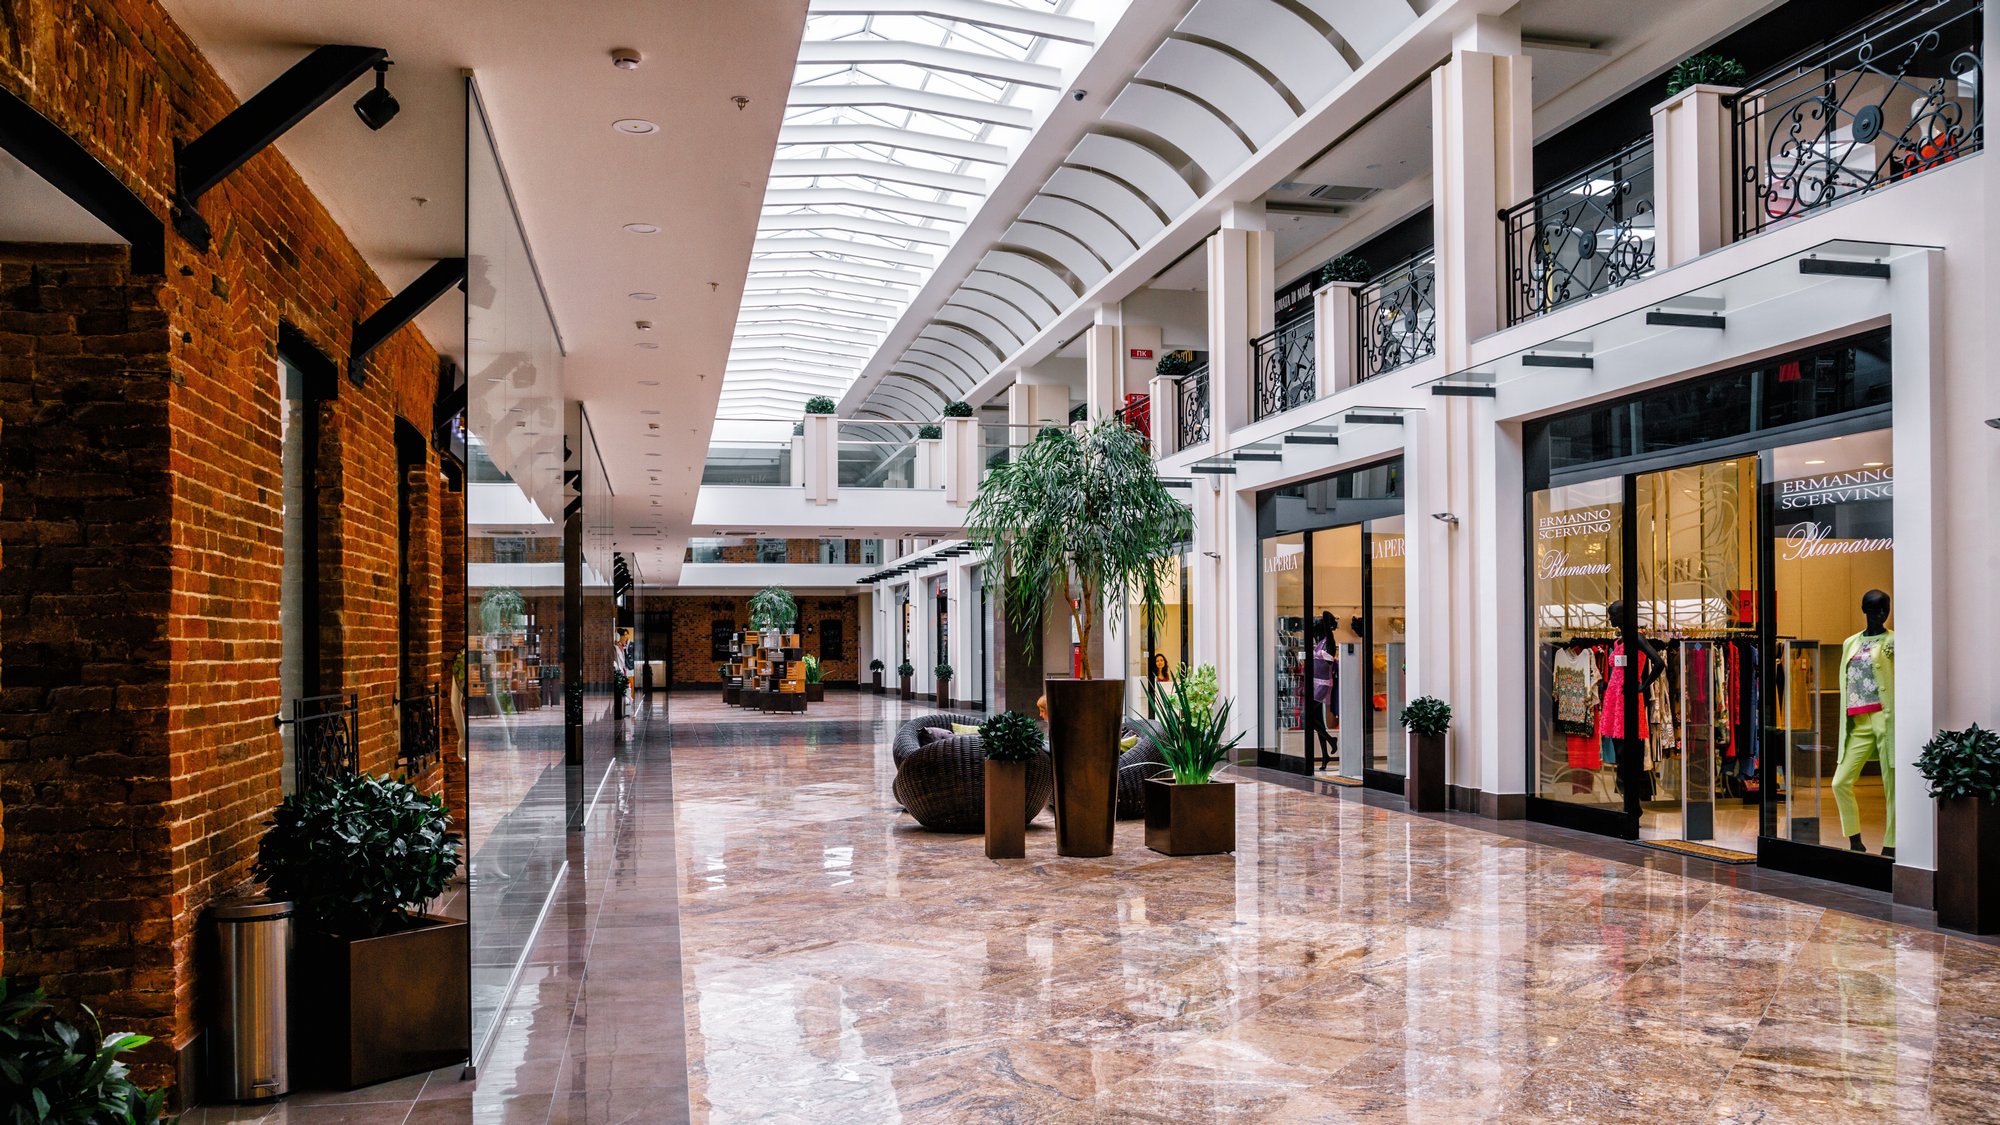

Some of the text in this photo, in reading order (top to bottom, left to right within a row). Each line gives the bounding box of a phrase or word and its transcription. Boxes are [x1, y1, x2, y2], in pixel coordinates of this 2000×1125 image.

[1539, 508, 1611, 528] ERMANNO
[1539, 522, 1611, 540] SCERVINO
[1782, 521, 1894, 561] Blumarin
[1538, 549, 1612, 580] Blumarine
